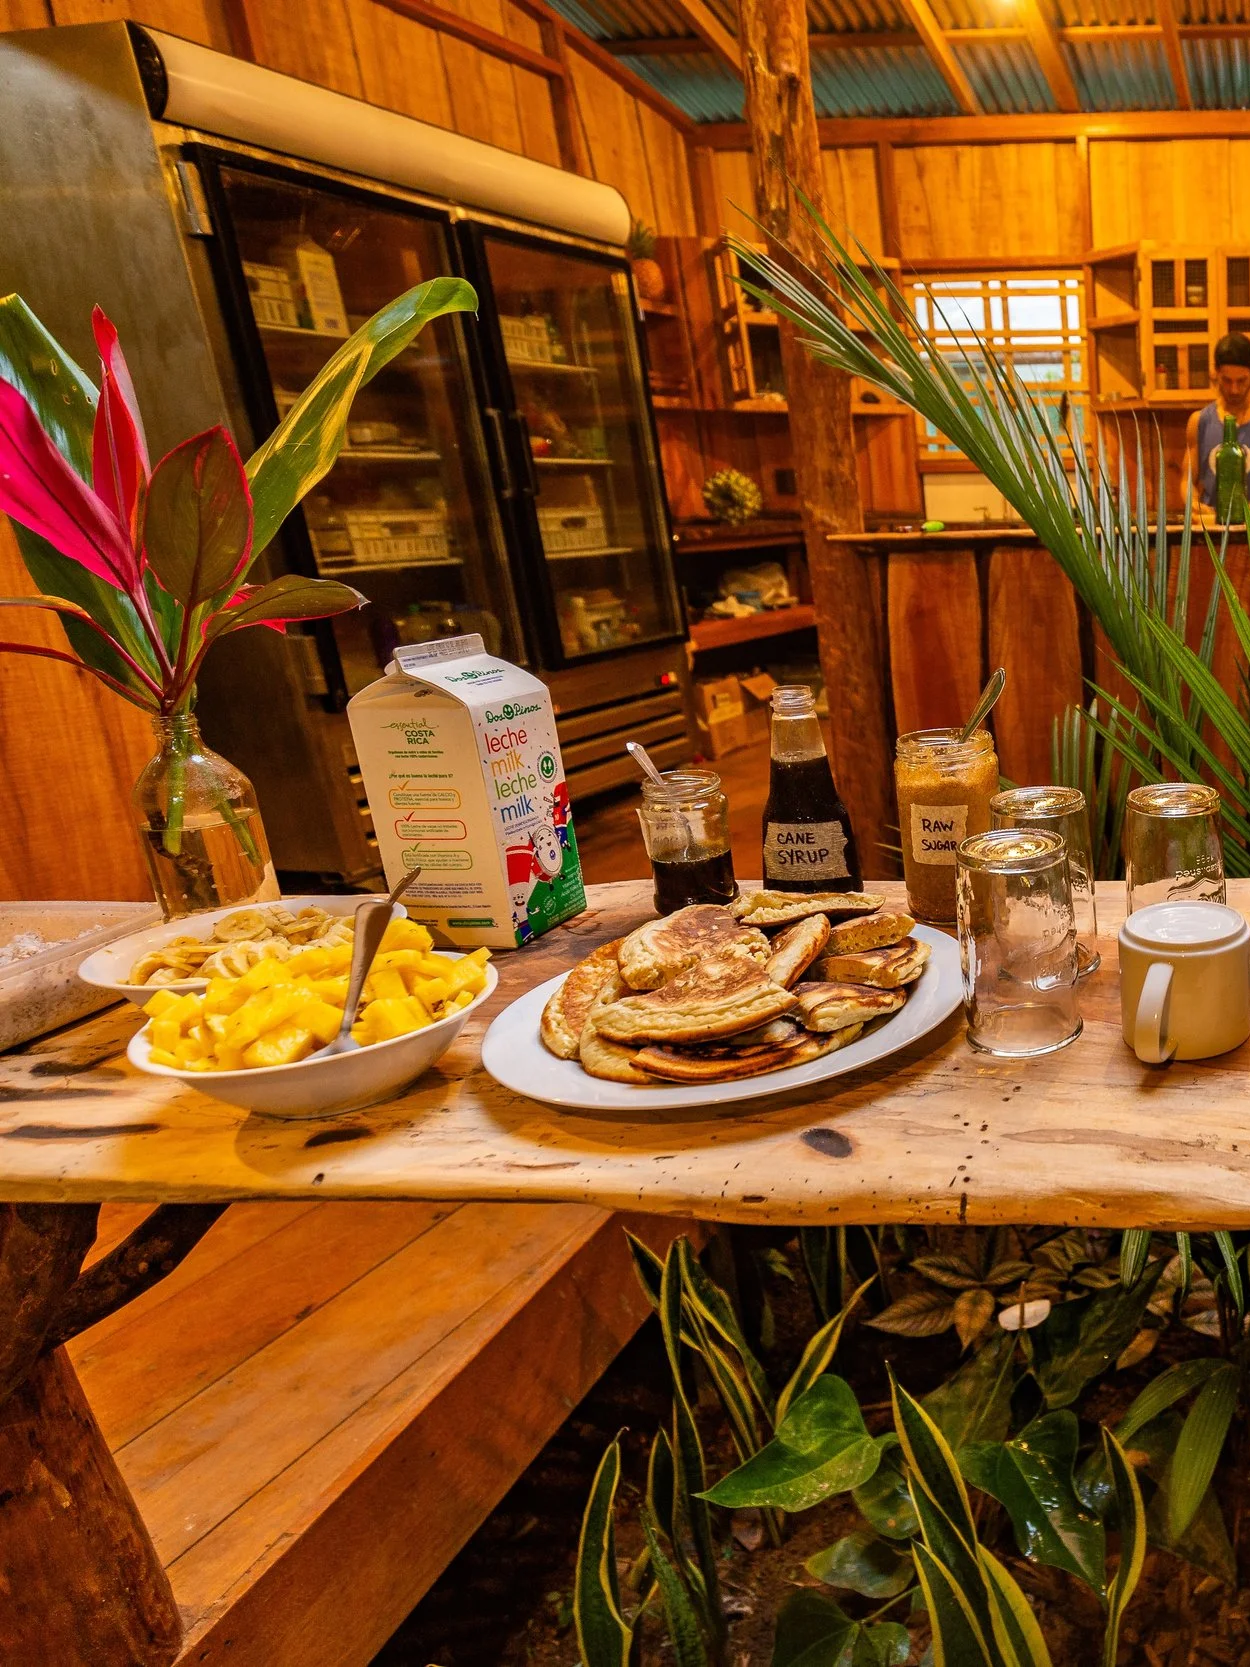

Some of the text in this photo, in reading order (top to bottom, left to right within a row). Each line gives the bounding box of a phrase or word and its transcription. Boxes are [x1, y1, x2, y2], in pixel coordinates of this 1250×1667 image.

[445, 675, 467, 683] Dos
[477, 668, 505, 677] Pinos
[485, 703, 541, 723] Dos Pinos
[407, 737, 429, 745] RICA
[484, 727, 528, 754] leche
[491, 749, 525, 777] milk
[494, 772, 538, 800] leche
[500, 794, 535, 823] milk
[921, 818, 955, 833] RAW
[776, 832, 816, 845] CANE
[921, 838, 957, 852] SUGAR
[777, 848, 830, 865] SYRUP
